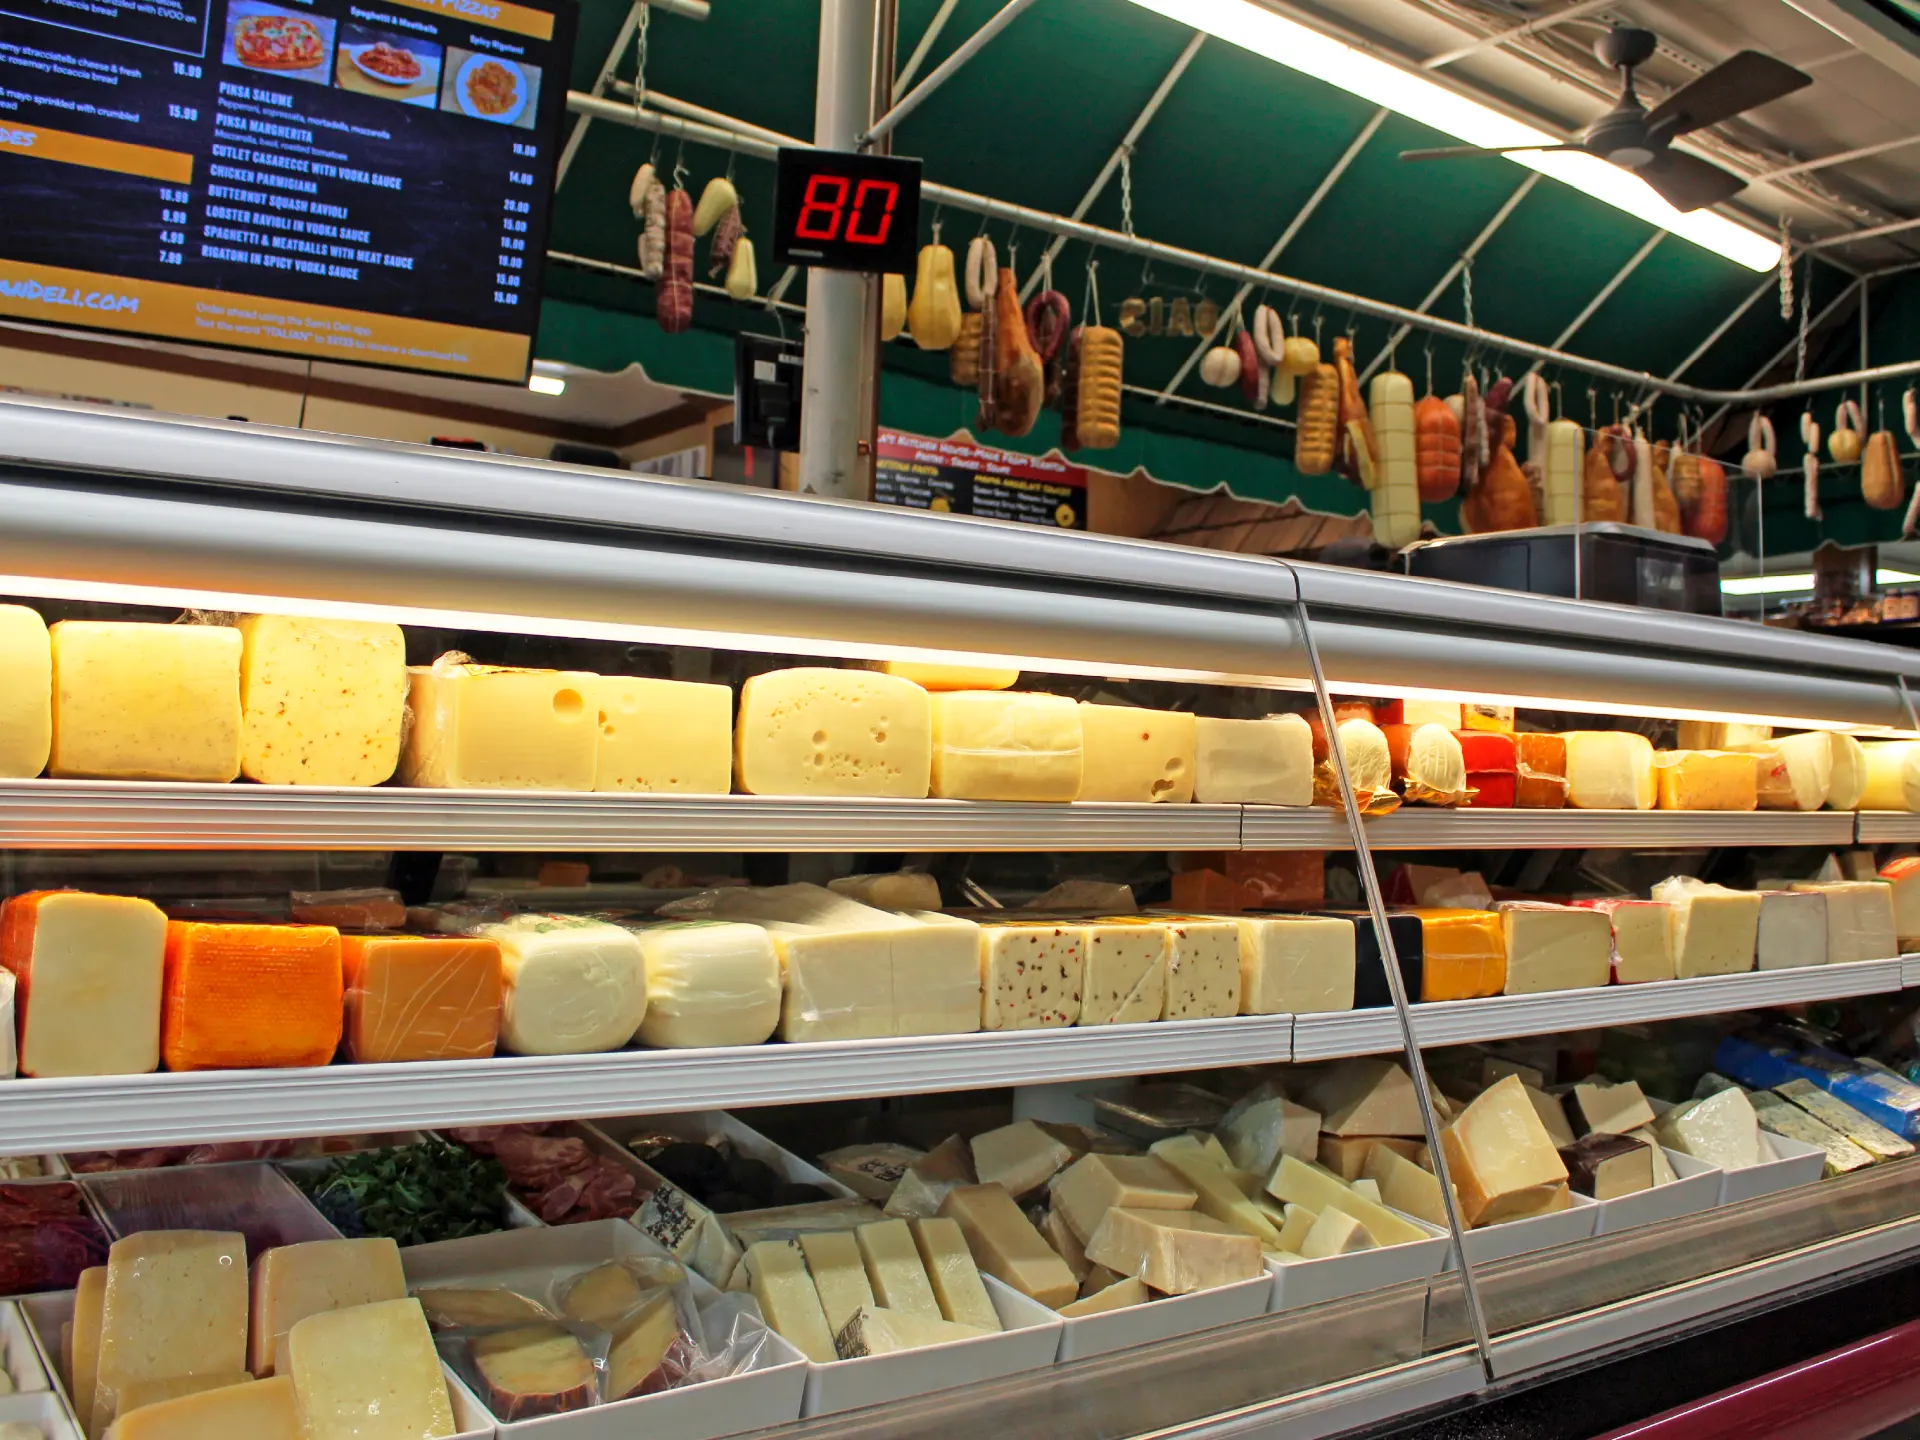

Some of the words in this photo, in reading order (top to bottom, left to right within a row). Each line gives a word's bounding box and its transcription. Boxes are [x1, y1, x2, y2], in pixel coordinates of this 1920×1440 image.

[0, 128, 38, 147] DES
[212, 144, 250, 162] CUTLET
[312, 163, 337, 178] WITH
[372, 174, 402, 190] SAUCE
[310, 202, 348, 220] RAVIOLI
[795, 174, 899, 245] 80
[252, 212, 292, 230] RAVIOLI
[340, 228, 371, 244] SAUCE
[204, 225, 260, 246] SPAGHETTI
[330, 245, 356, 260] WITH
[384, 254, 414, 270] SAUCE
[250, 253, 263, 266] IN
[264, 254, 293, 271] SPICY
[328, 264, 360, 281] SAUCE
